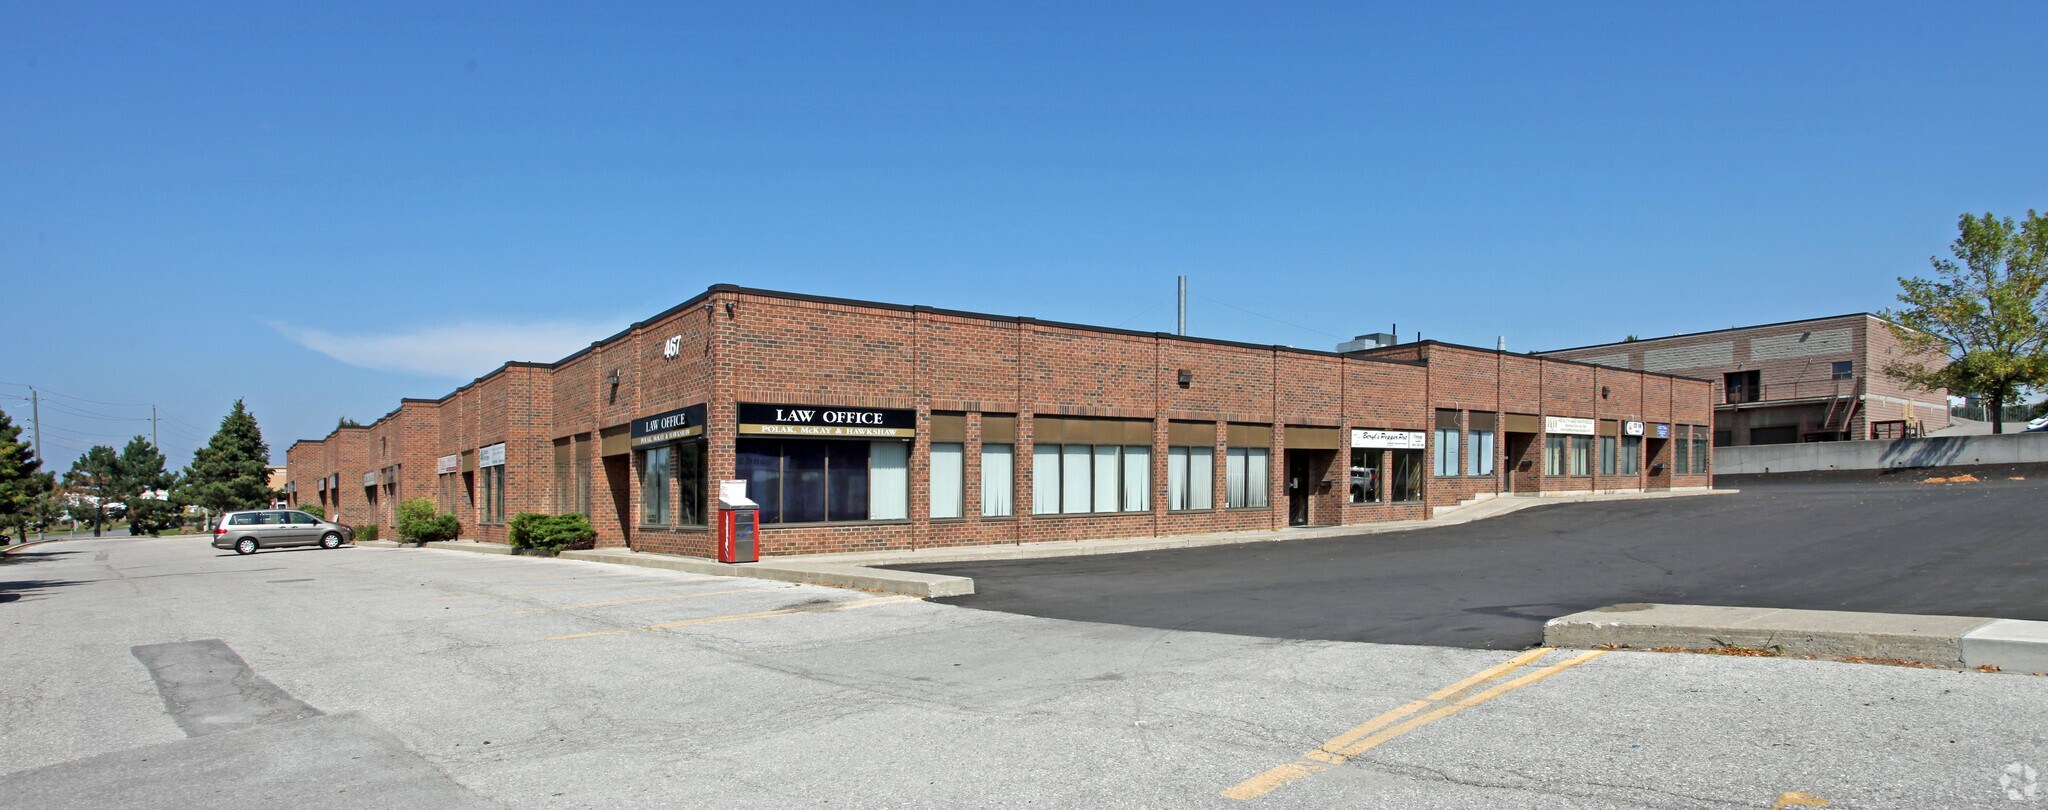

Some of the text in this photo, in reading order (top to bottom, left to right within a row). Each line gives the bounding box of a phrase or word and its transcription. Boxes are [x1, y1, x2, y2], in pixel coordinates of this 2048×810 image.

[664, 335, 681, 358] 467
[645, 413, 686, 433] LAW OFFICE
[776, 409, 884, 425] LAW OFFICE
[761, 425, 797, 434] POLAK,
[800, 427, 832, 435] McKAY
[846, 428, 898, 436] HAWKSHAW
[1380, 432, 1399, 441] Pepper
